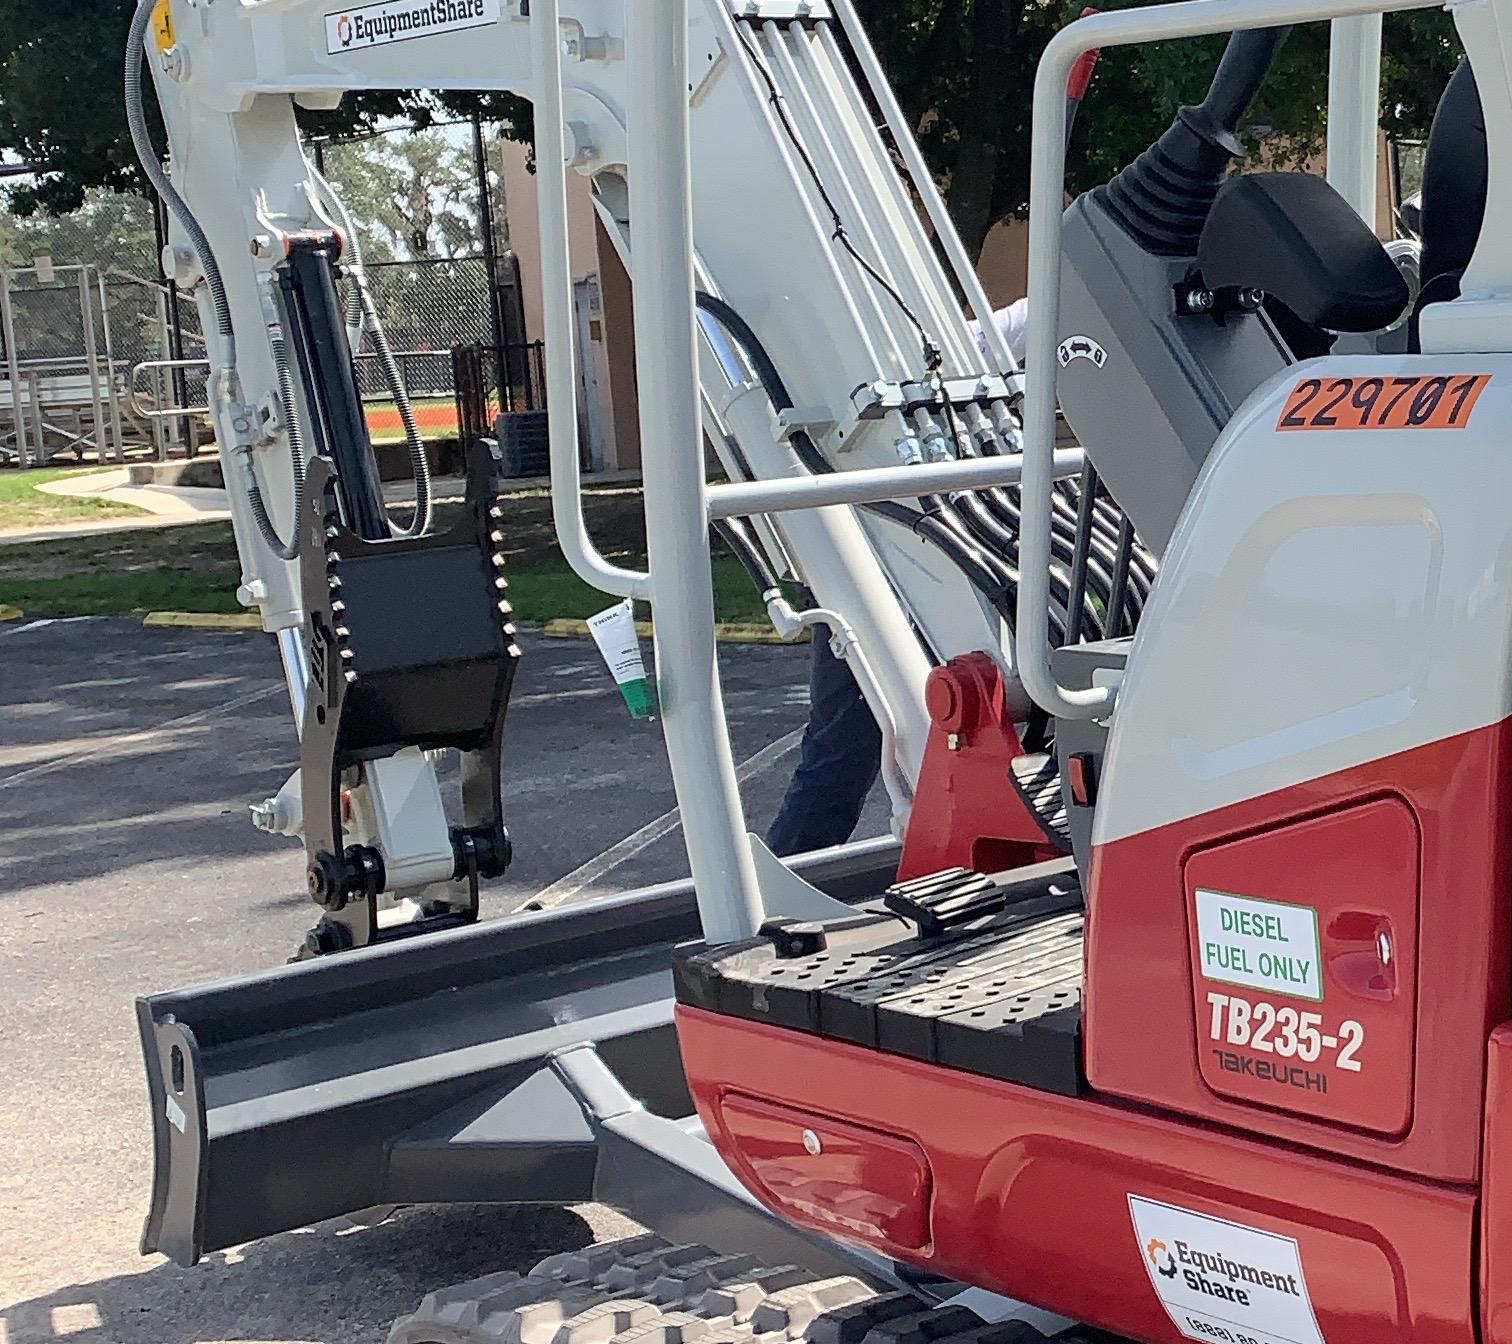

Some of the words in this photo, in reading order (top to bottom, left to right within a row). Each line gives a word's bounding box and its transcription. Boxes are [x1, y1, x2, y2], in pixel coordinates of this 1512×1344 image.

[1280, 375, 1480, 426] 229701
[1219, 907, 1289, 942] DIESEL
[1205, 942, 1253, 974] FUEL
[1258, 952, 1310, 984] ONLY
[1207, 992, 1364, 1072] TB235-2
[1212, 1049, 1328, 1094] TAKEUCHI
[1174, 1240, 1300, 1296] Equipment
[1183, 1269, 1250, 1306] Share
[1185, 1316, 1234, 1344] (888)
